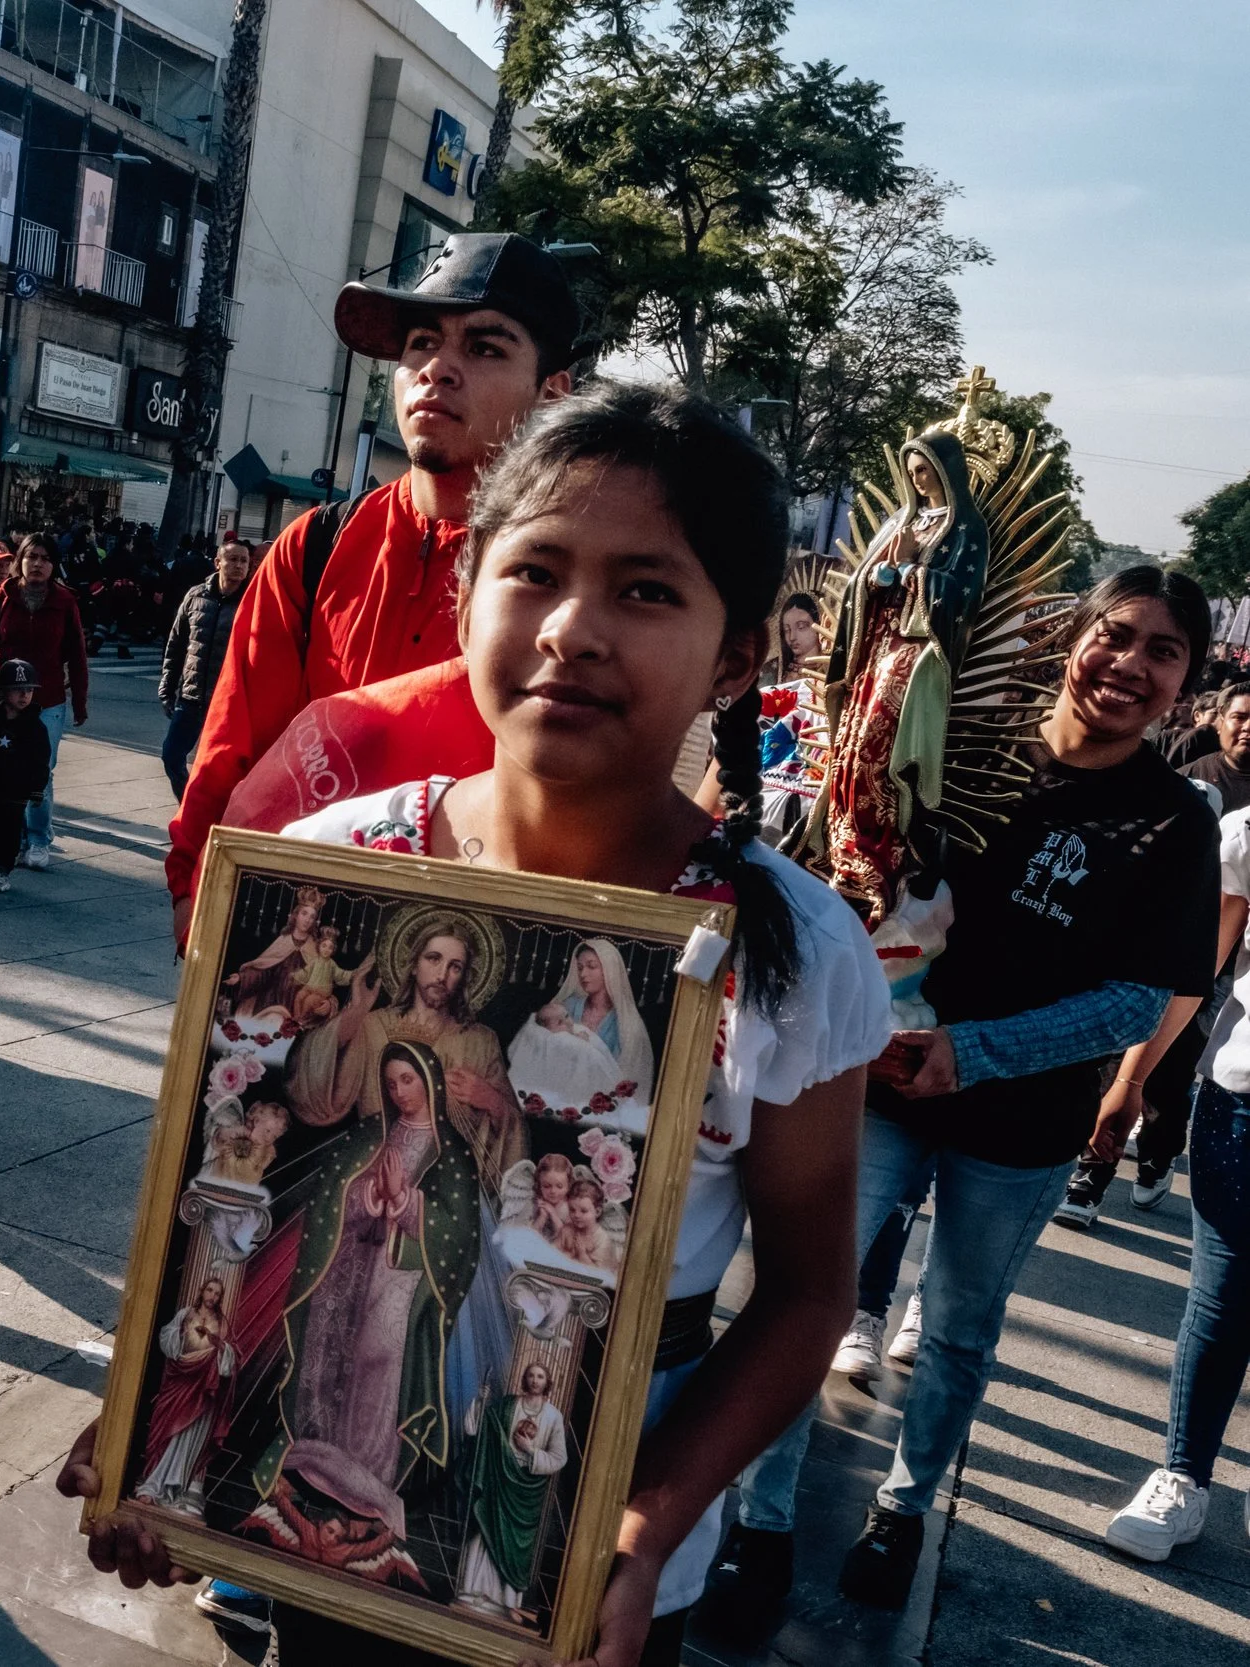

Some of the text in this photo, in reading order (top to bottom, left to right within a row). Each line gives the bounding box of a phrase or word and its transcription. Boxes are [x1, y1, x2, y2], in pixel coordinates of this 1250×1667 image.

[53, 375, 60, 384] El
[59, 376, 72, 387] Paso
[1011, 889, 1073, 927] Crazy Boy
